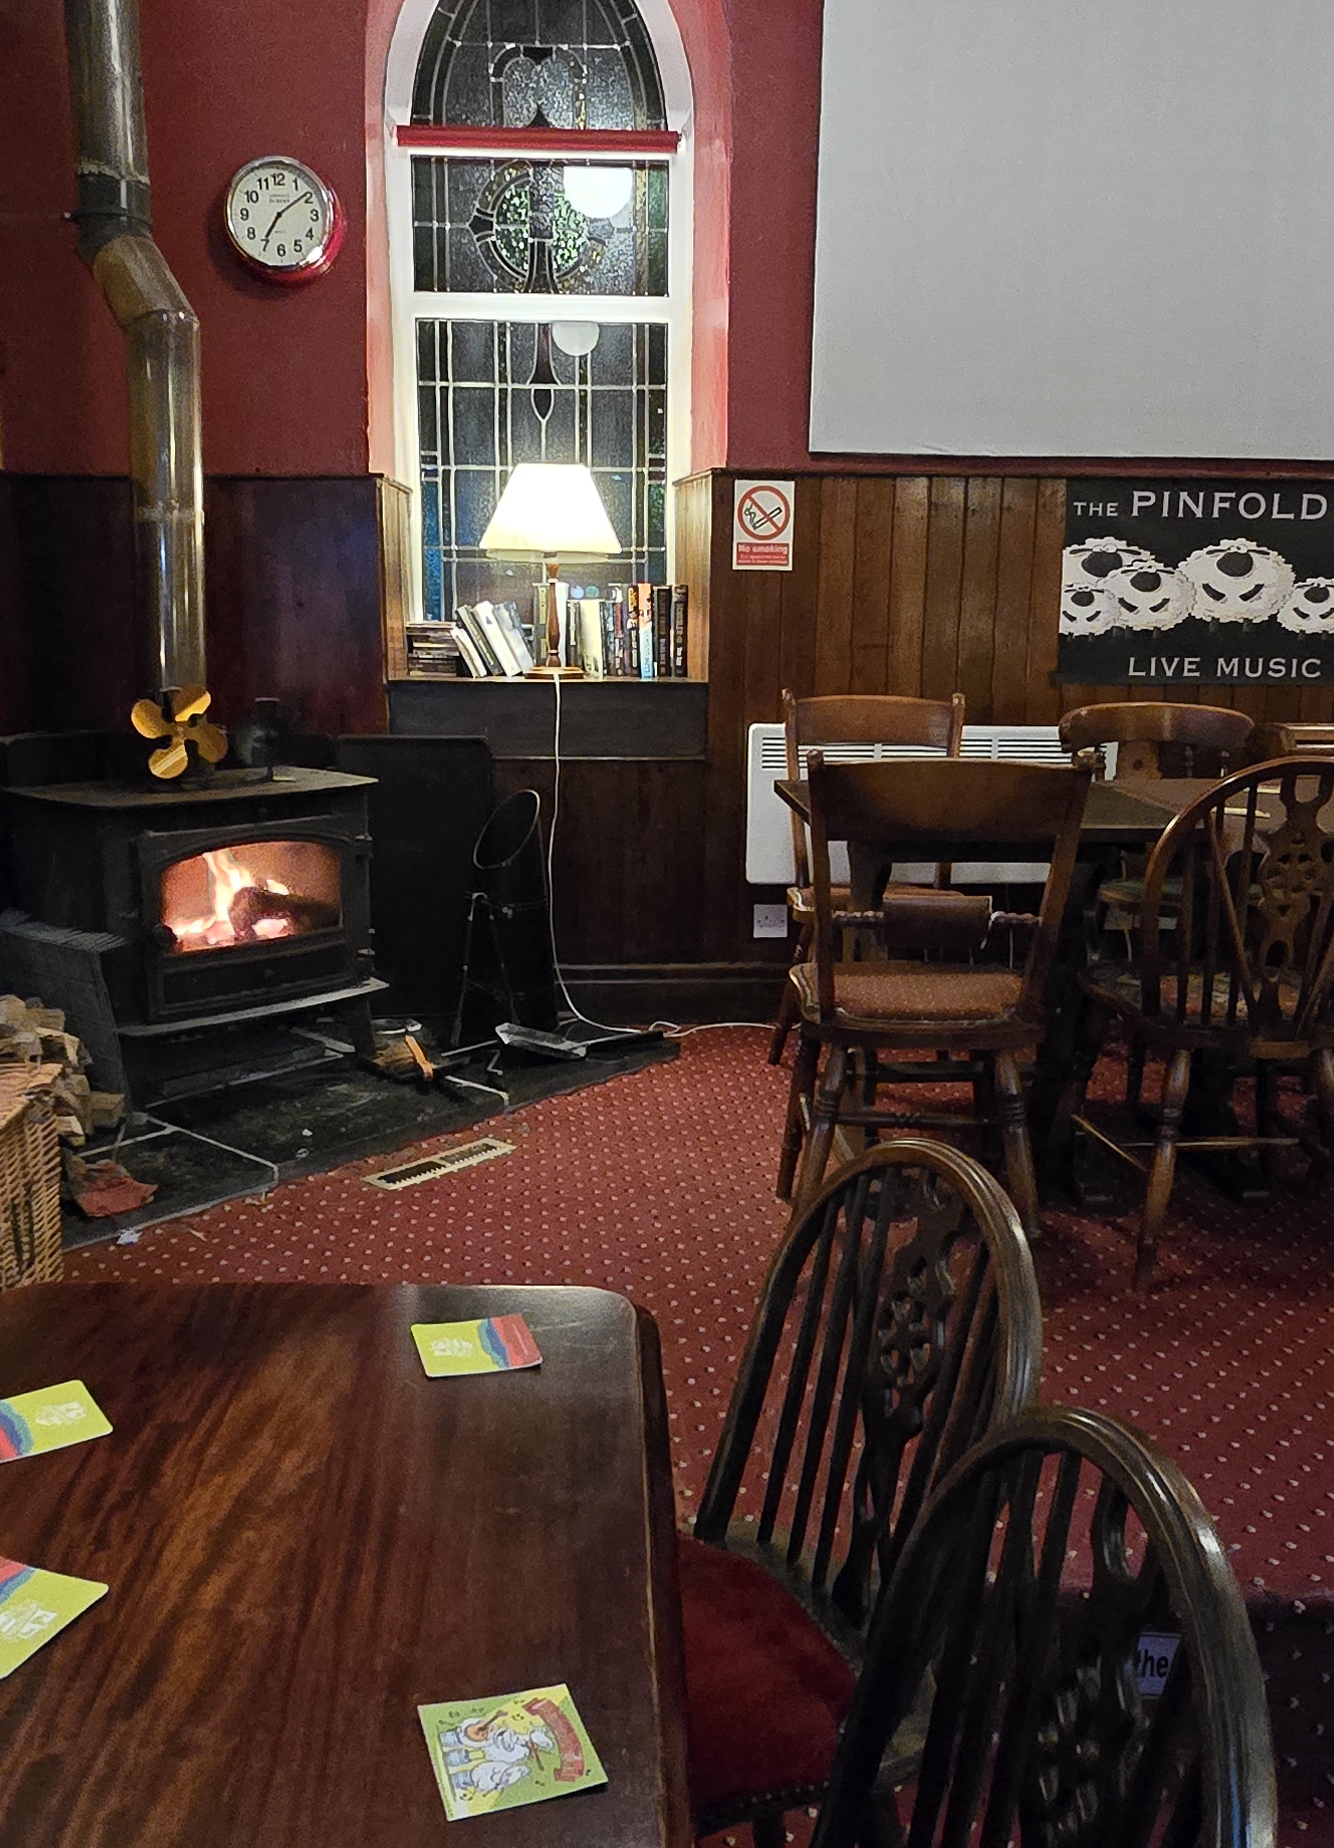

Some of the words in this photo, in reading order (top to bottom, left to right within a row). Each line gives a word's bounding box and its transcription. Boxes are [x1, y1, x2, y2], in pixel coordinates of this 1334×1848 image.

[256, 177, 270, 191] 11
[270, 172, 286, 187] 12
[292, 178, 299, 191] 1
[244, 190, 259, 204] 10
[304, 191, 314, 205] 2
[239, 207, 249, 221] 9
[309, 208, 319, 222] 3
[247, 226, 256, 240] 8
[305, 226, 315, 240] 4
[259, 238, 270, 252] 7
[276, 243, 287, 257] 6
[293, 239, 303, 253] 5
[1072, 501, 1119, 518] THE
[1130, 490, 1329, 521] PINFOLD
[738, 544, 750, 553] No
[752, 544, 788, 554] smoking
[1127, 656, 1201, 677] LIVE
[1215, 657, 1323, 678] MUSIC
[1138, 1648, 1169, 1678] he
